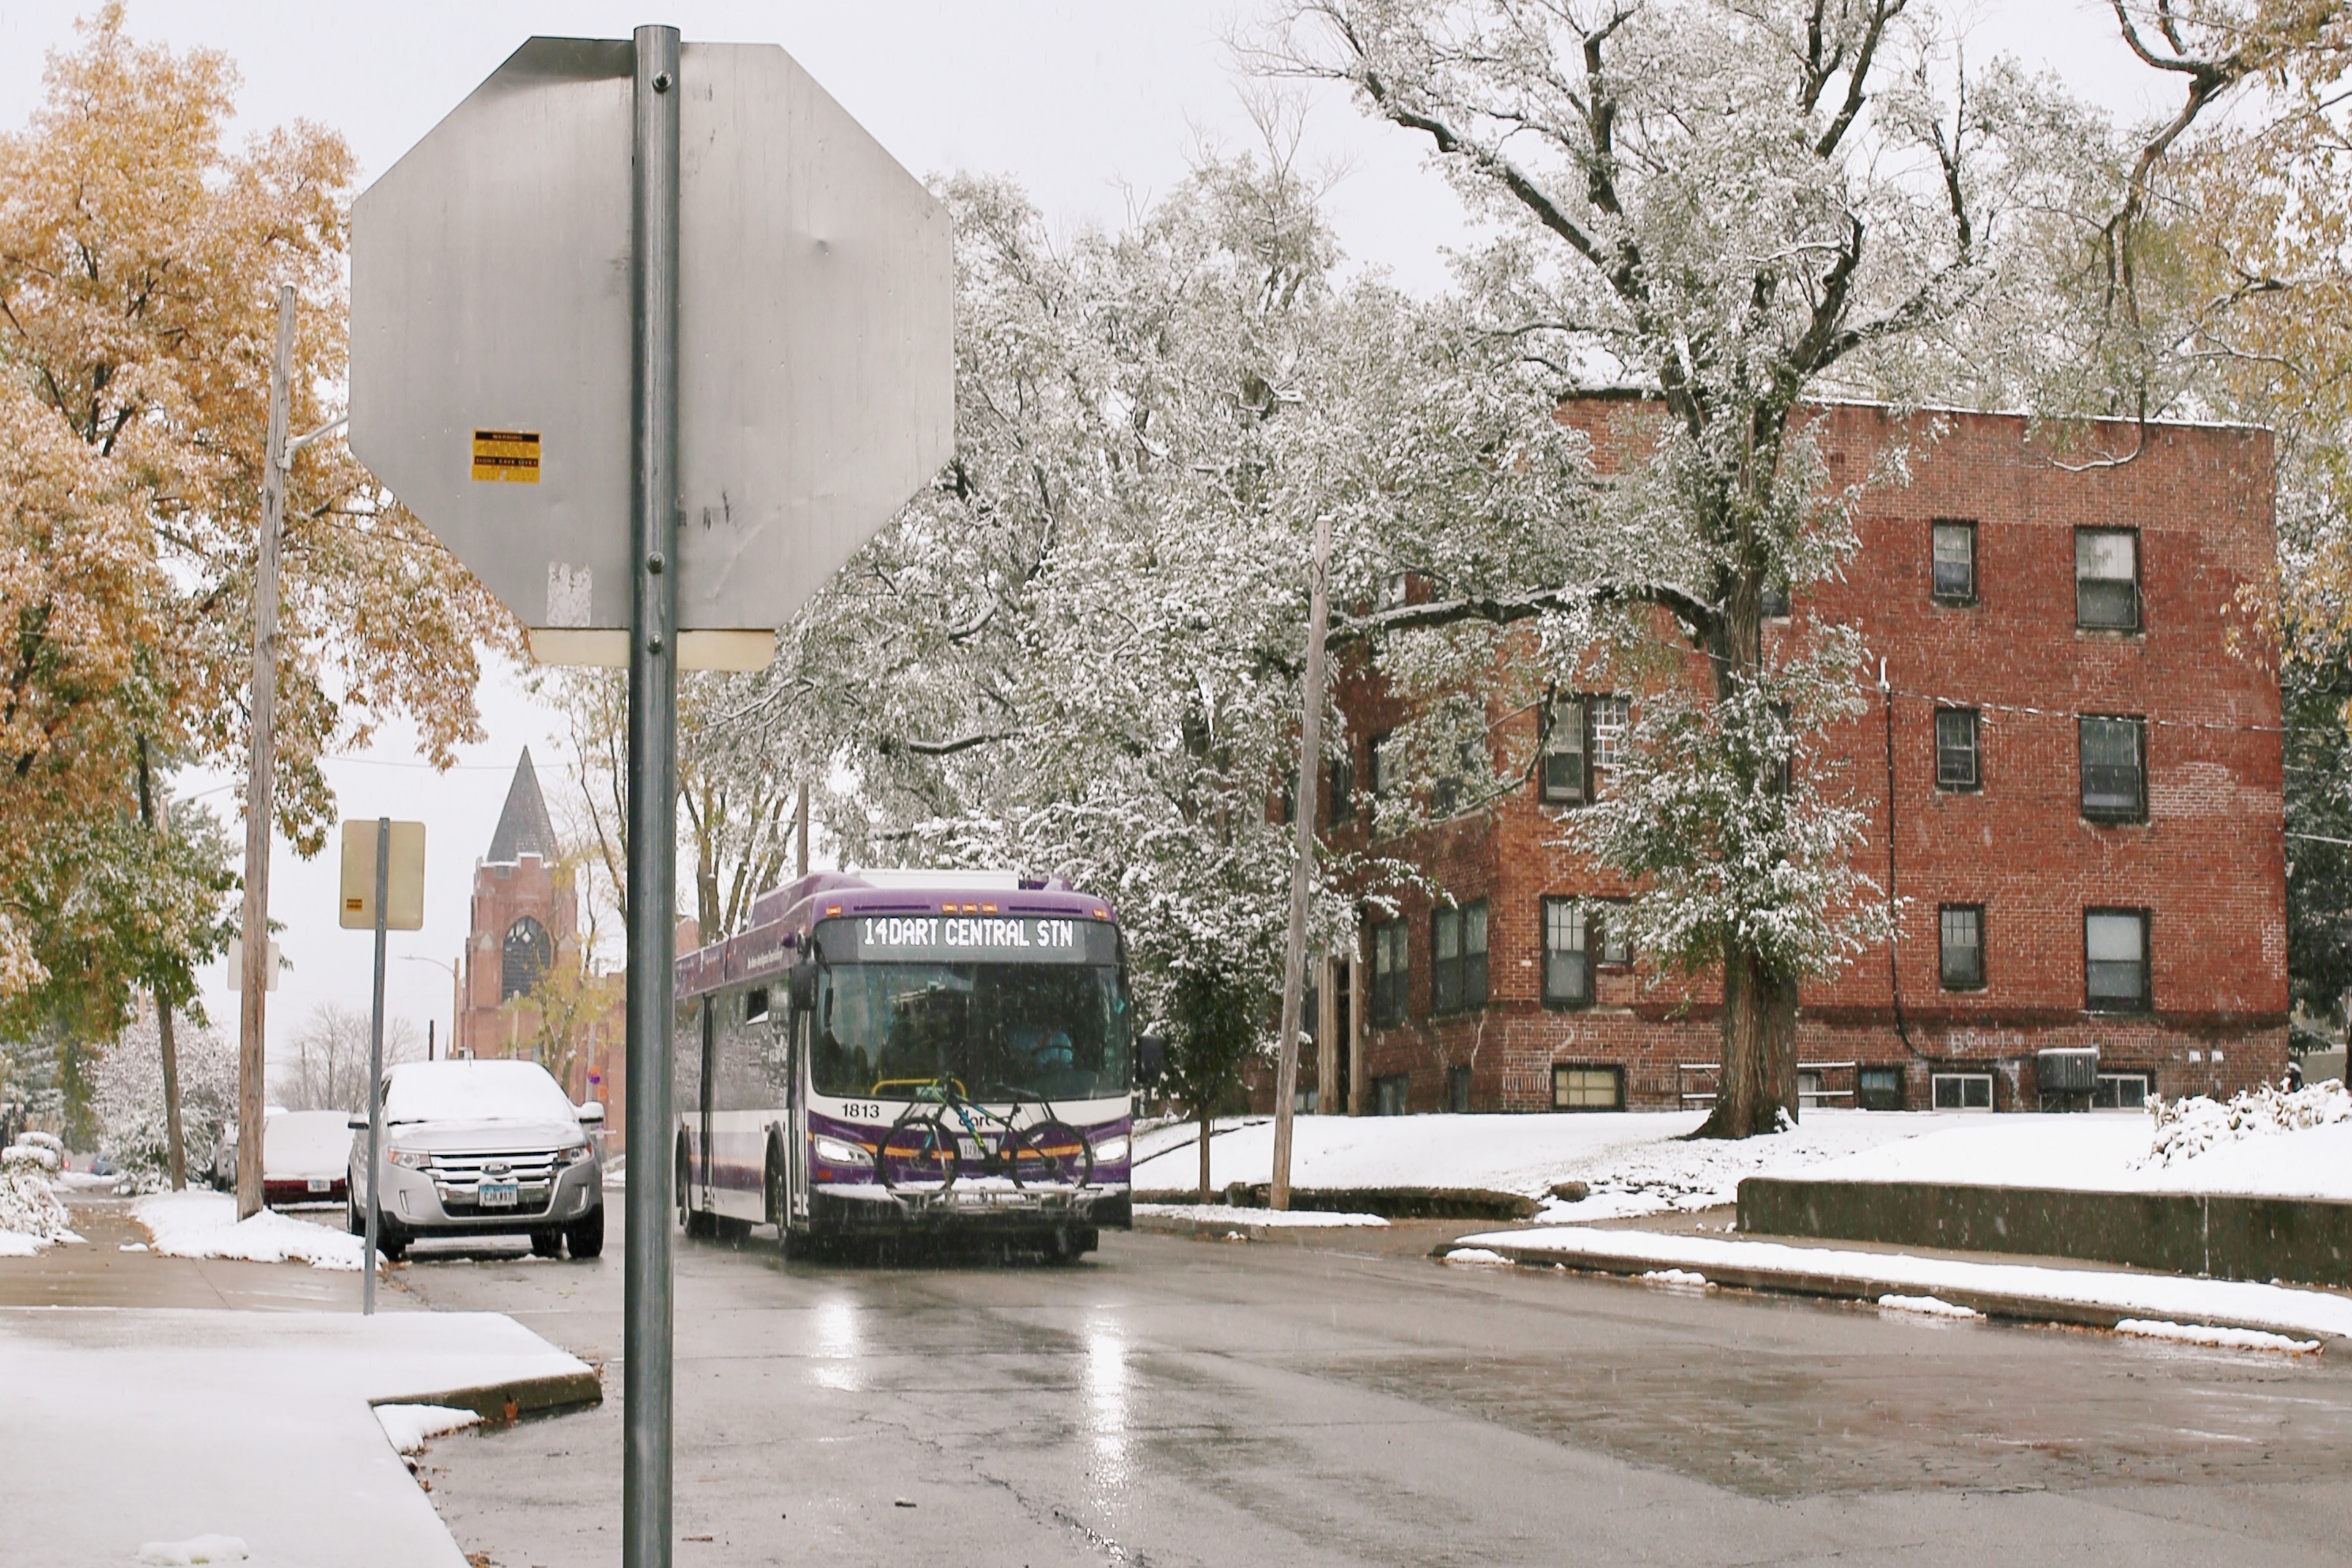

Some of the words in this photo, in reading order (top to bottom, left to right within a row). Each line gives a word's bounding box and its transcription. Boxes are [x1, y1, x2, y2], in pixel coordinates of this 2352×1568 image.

[944, 918, 1031, 947] CENTRAL
[1036, 918, 1074, 948] STN
[842, 1103, 880, 1119] 1813
